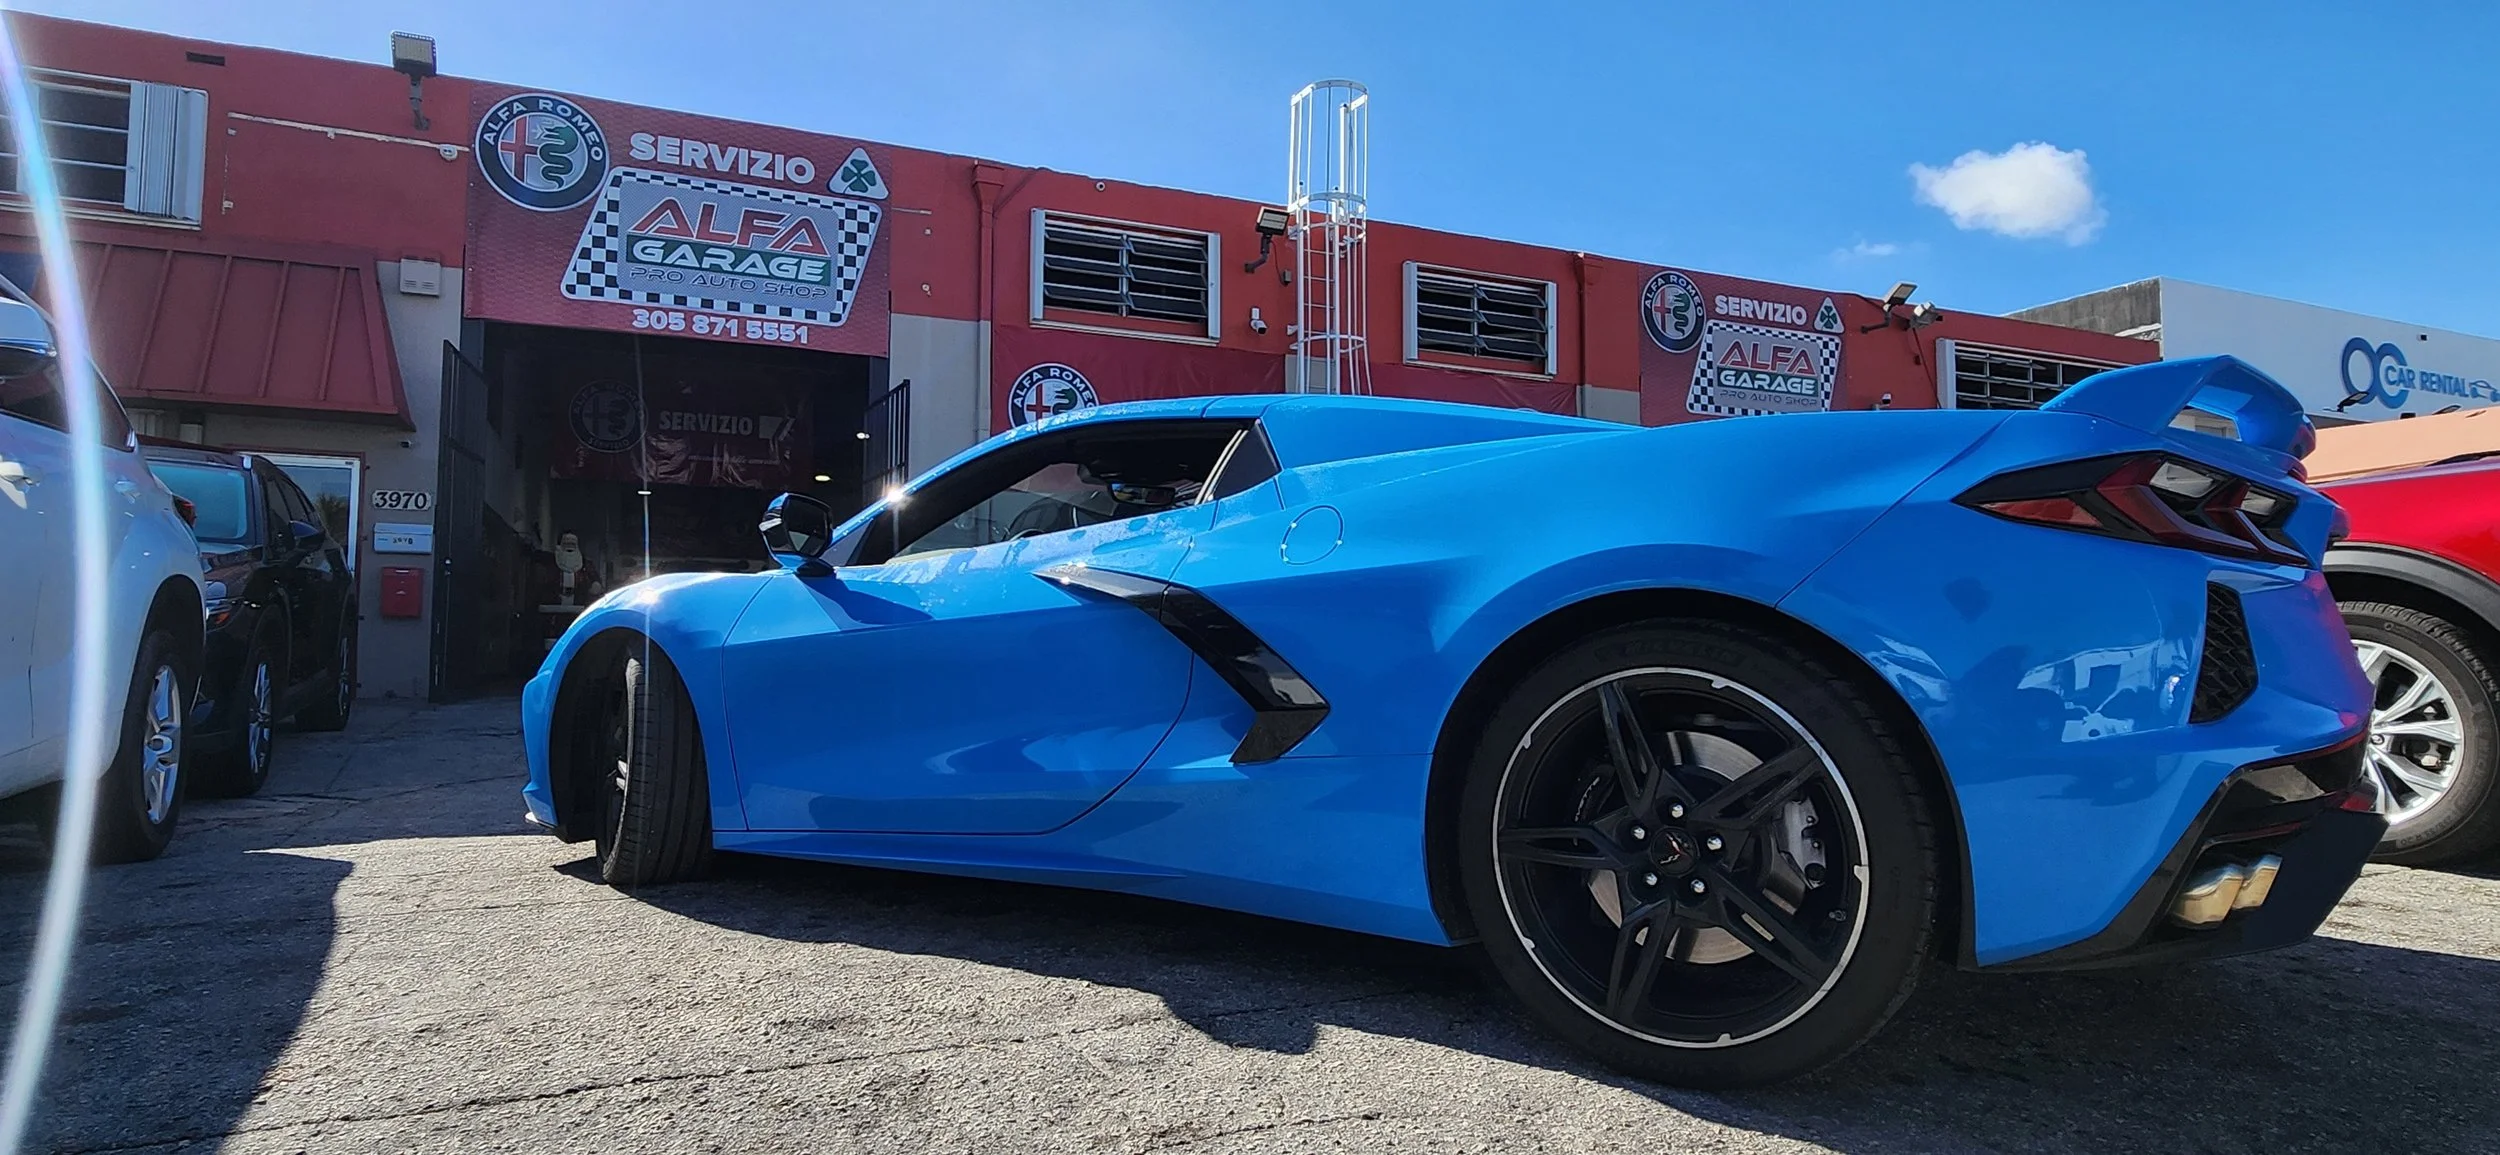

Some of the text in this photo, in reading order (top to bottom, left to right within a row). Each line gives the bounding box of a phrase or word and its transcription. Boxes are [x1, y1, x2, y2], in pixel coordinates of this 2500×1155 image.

[483, 99, 604, 161] ALFA ROMEO
[629, 132, 815, 184] SERVIZIO
[626, 196, 831, 257] ALFA
[632, 239, 828, 283] GARAGE
[630, 266, 829, 300] PRO AUTO SHOP
[1645, 275, 1704, 317] ALFA ROMEO
[632, 309, 809, 344] 305 871 5551
[1715, 294, 1807, 326] SERVIZIO
[1718, 339, 1818, 376] ALFA
[1013, 371, 1043, 408] ALFA
[1719, 370, 1817, 395] GARAGE
[1720, 390, 1818, 407] PRO AUTO SHOP
[2384, 365, 2470, 397] CAR RENTAL
[659, 411, 753, 436] SERVIZIO
[375, 491, 427, 509] 3970
